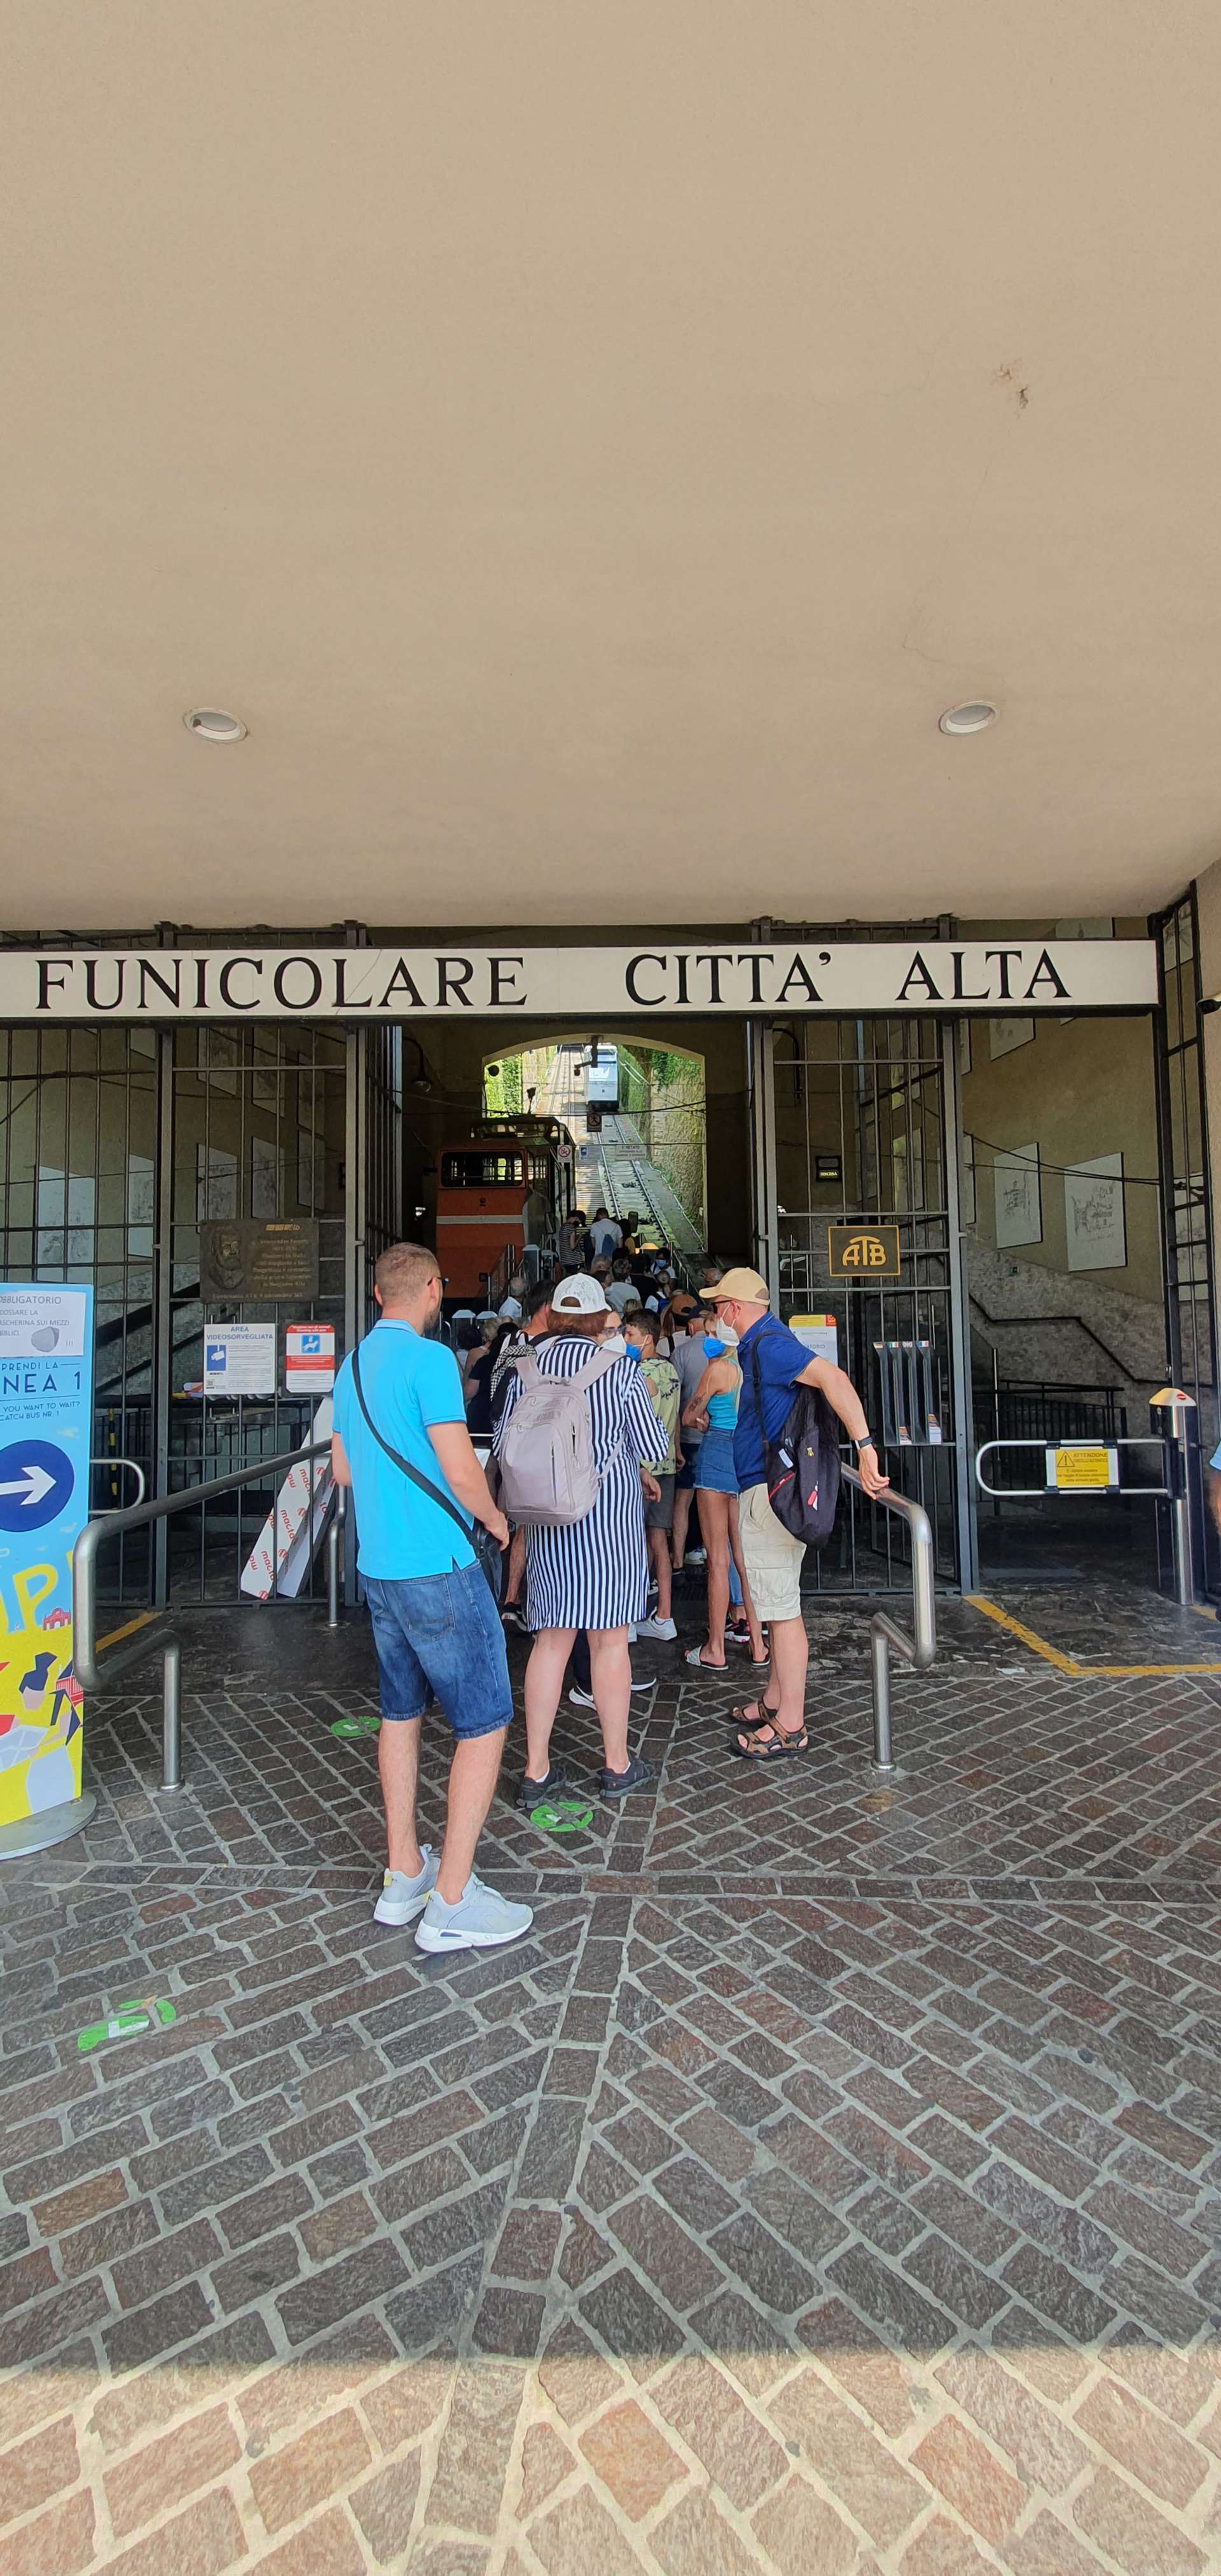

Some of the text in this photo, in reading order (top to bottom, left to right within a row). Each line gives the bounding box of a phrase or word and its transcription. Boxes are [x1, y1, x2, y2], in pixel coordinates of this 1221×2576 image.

[35, 948, 1072, 1010] FUNICOLARE CITTA' ALTA
[842, 1236, 886, 1266] ATB
[1, 1361, 59, 1371] PRENDI LA
[3, 1371, 81, 1395] NEA 1
